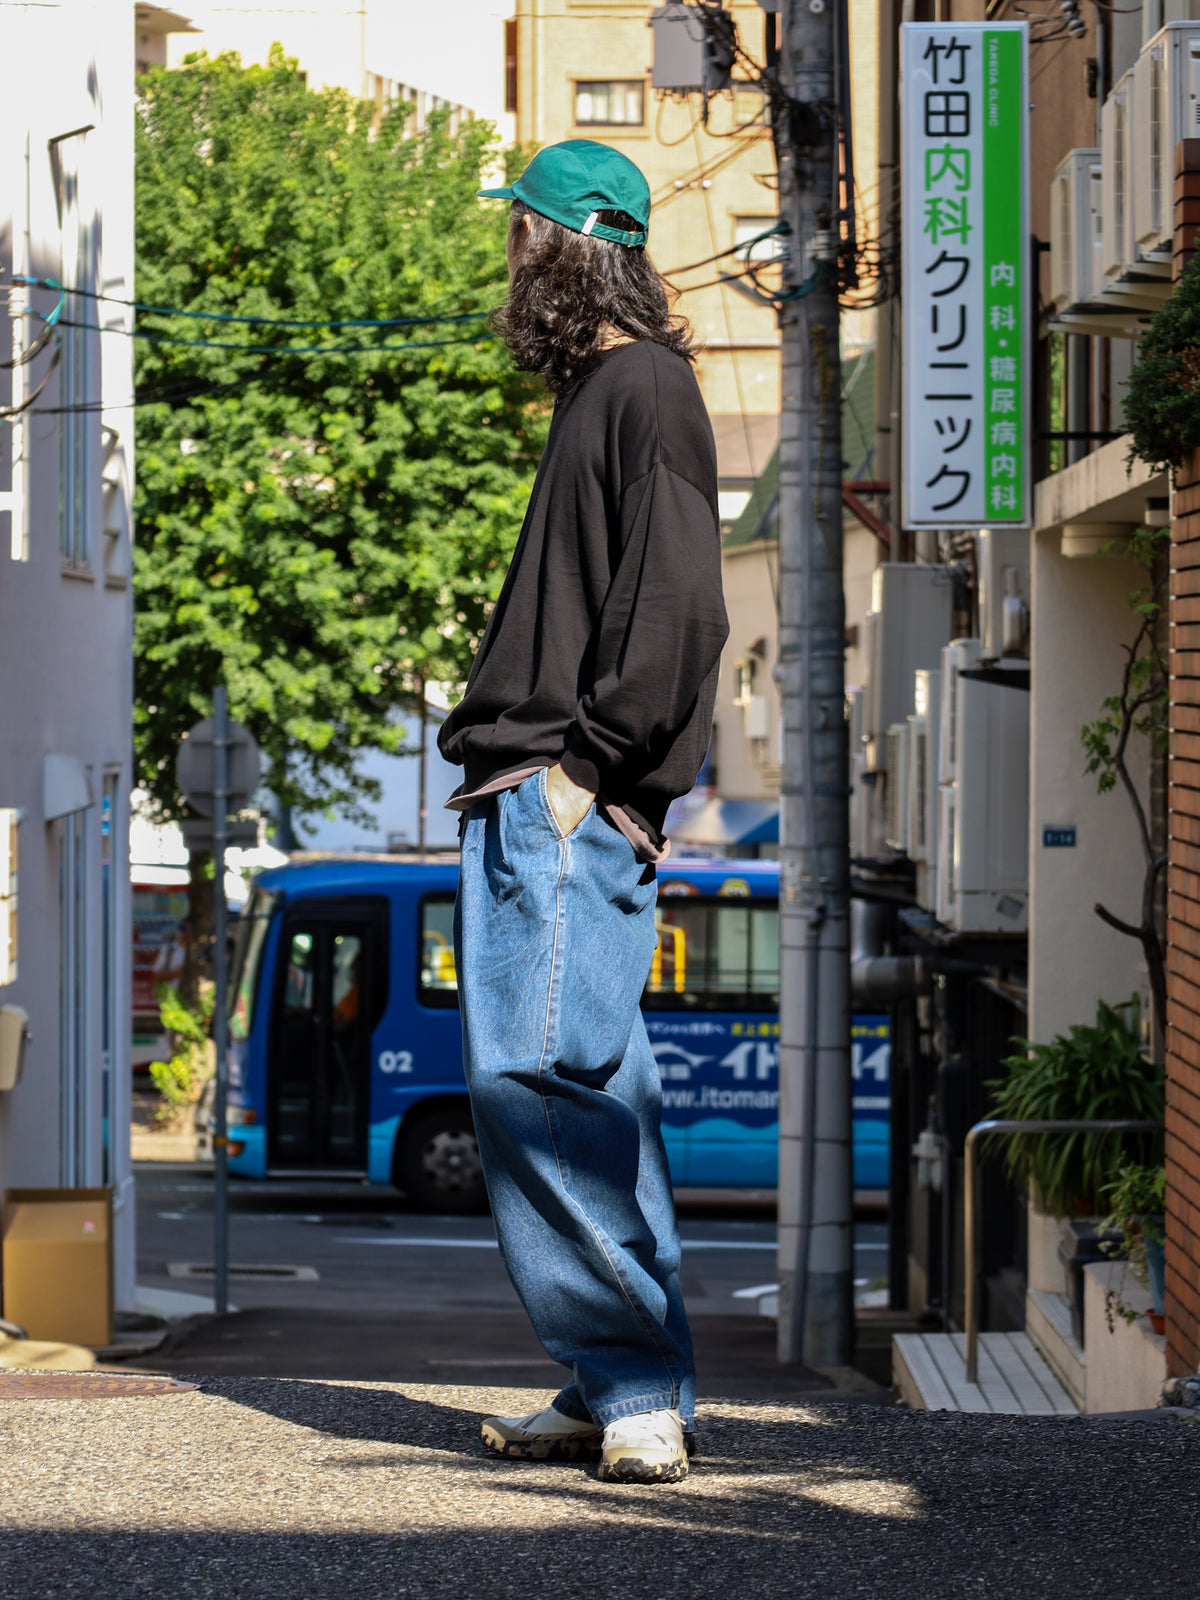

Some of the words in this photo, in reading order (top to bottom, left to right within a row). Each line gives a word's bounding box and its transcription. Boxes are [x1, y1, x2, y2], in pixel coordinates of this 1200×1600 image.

[989, 38, 999, 85] TAKEDA
[989, 87, 999, 127] CLINIC
[923, 36, 973, 511] 竹田内科クリニック
[989, 261, 1017, 510] 内科・糖尿病内科
[378, 1050, 413, 1073] 02
